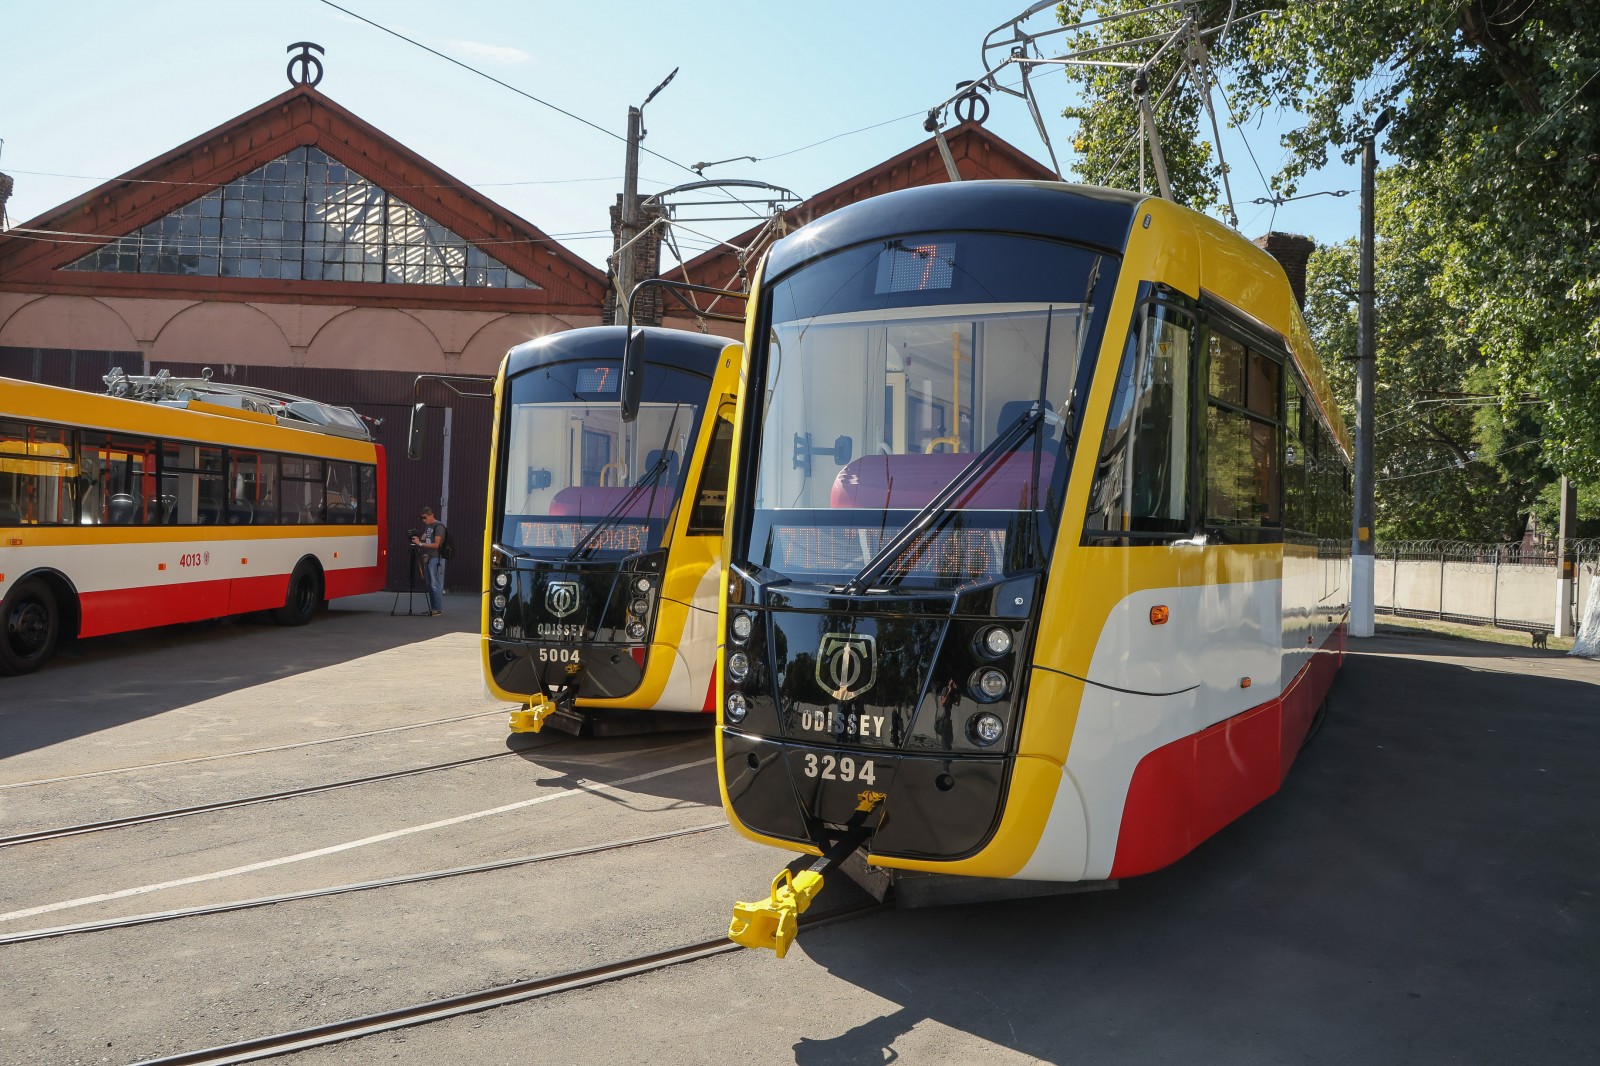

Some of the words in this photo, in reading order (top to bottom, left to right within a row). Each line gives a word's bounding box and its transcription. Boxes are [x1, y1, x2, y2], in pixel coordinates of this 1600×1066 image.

[912, 245, 936, 290] 7
[594, 367, 609, 392] 7
[180, 553, 201, 567] 4013
[537, 623, 585, 637] ODISSEY
[539, 648, 580, 663] 5004
[802, 711, 885, 737] ODISSEY
[804, 754, 875, 785] 3294
